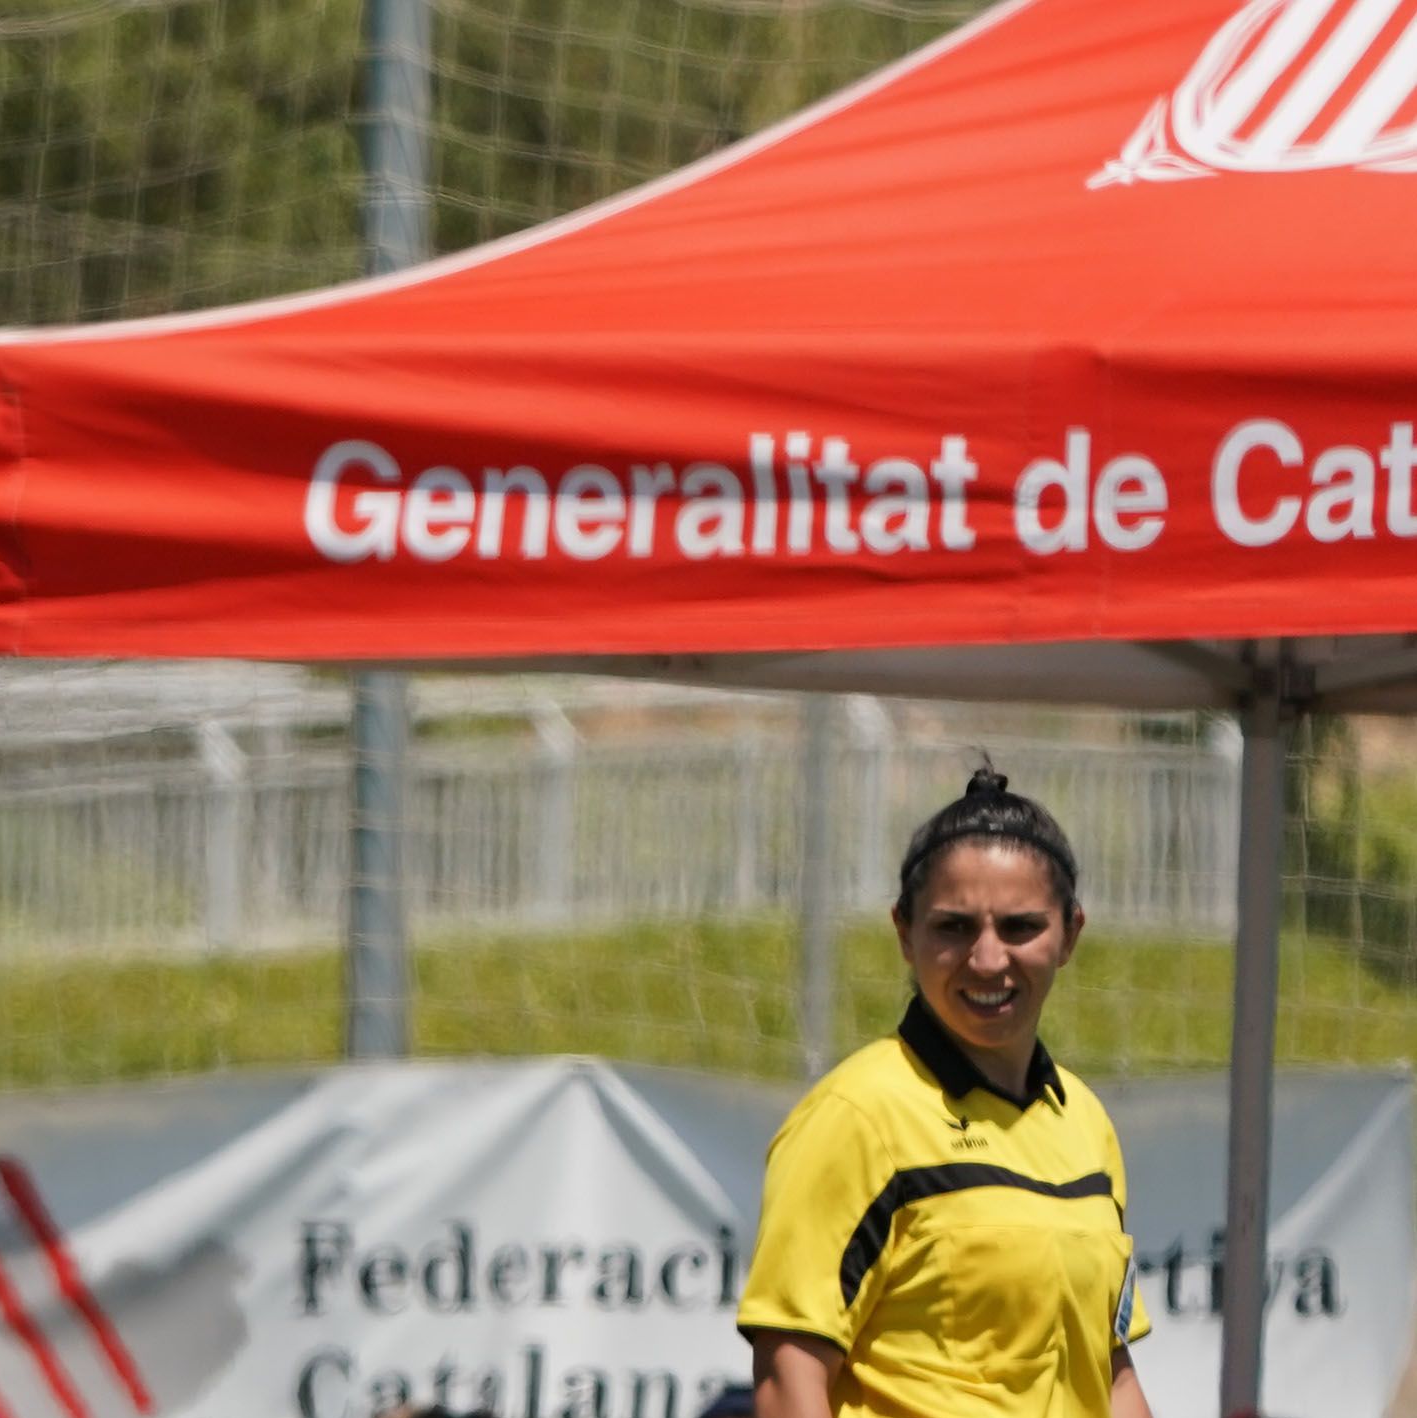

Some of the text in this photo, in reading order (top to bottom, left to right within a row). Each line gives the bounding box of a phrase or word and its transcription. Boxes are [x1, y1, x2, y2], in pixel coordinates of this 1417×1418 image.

[304, 428, 979, 562] Generalitat
[1015, 426, 1168, 555] de
[296, 1219, 741, 1315] Federaci
